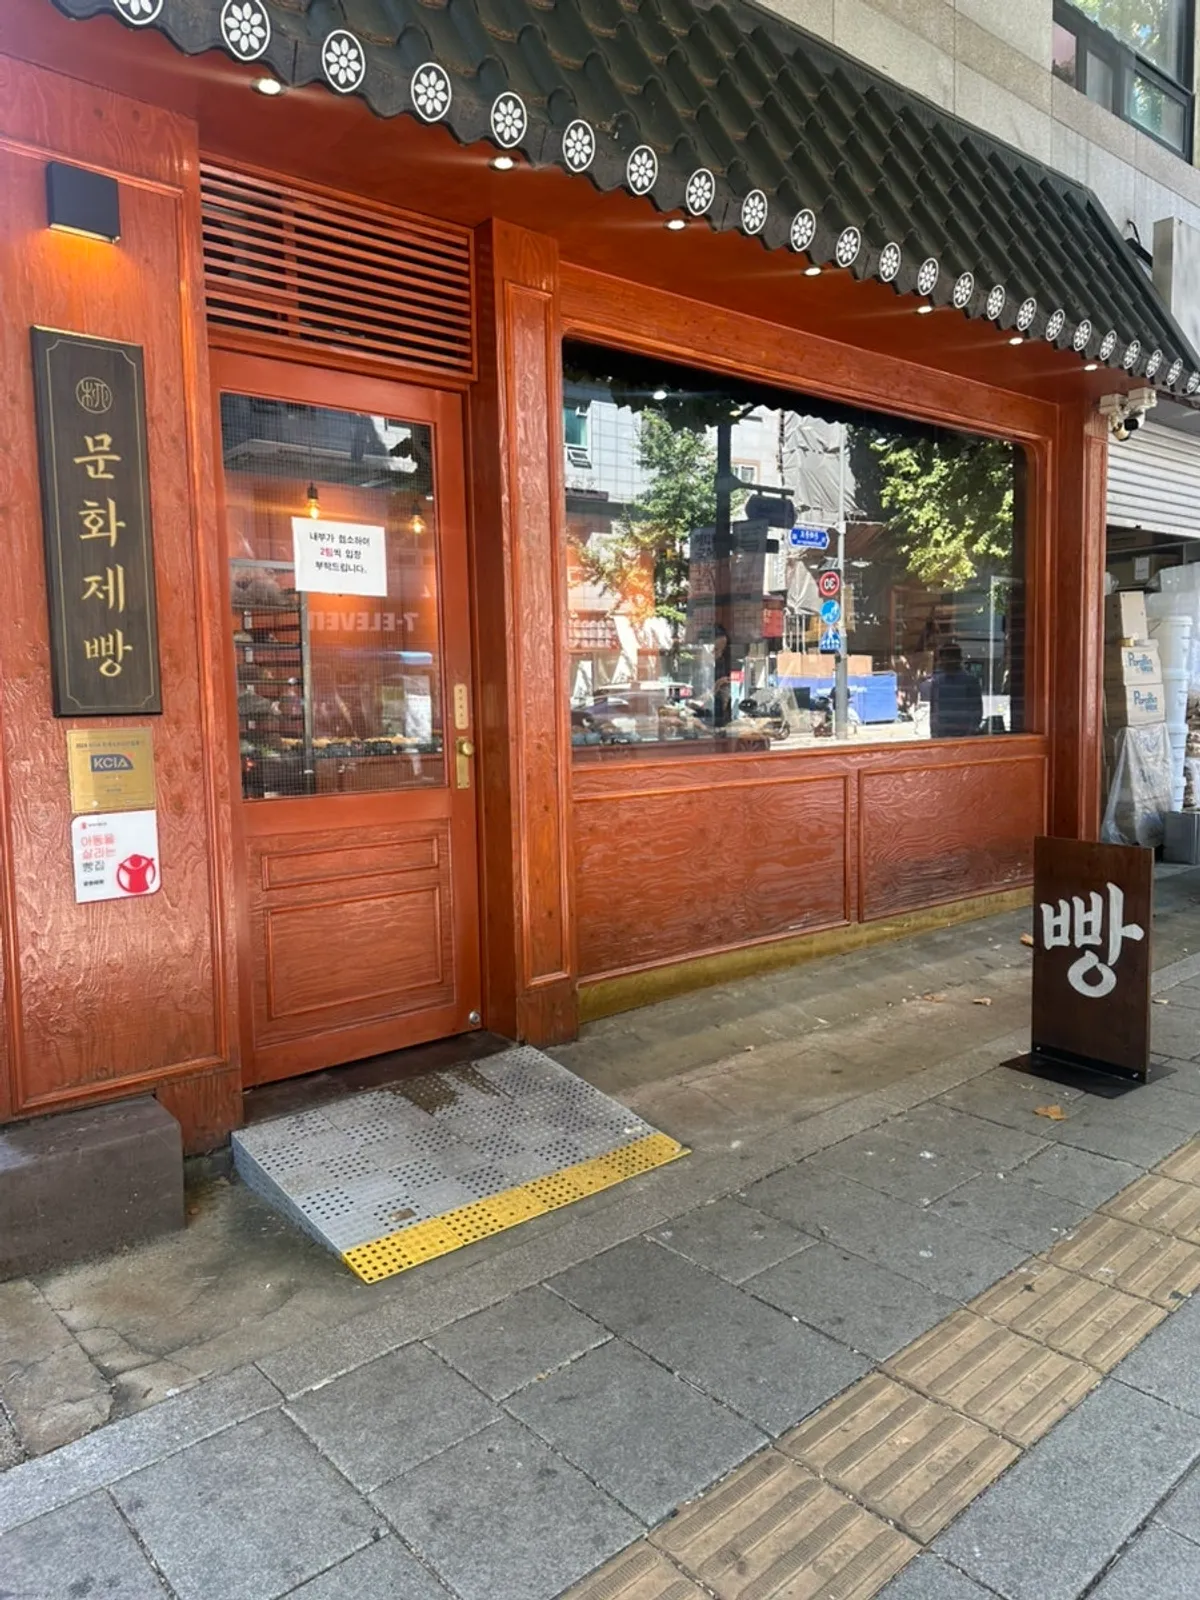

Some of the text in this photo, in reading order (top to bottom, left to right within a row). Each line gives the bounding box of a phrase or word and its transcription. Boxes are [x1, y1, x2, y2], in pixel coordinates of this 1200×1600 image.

[309, 531, 371, 546] 내부가 협소하여
[73, 434, 133, 678] 문화제빵
[319, 547, 362, 560] 2팀씩 입장
[315, 561, 368, 574] 부탁드립니다.
[93, 757, 128, 769] KCIA
[80, 834, 115, 848] 아동을
[82, 848, 116, 860] 살리는
[82, 860, 104, 873] 빵집
[1040, 881, 1146, 999] 빵
